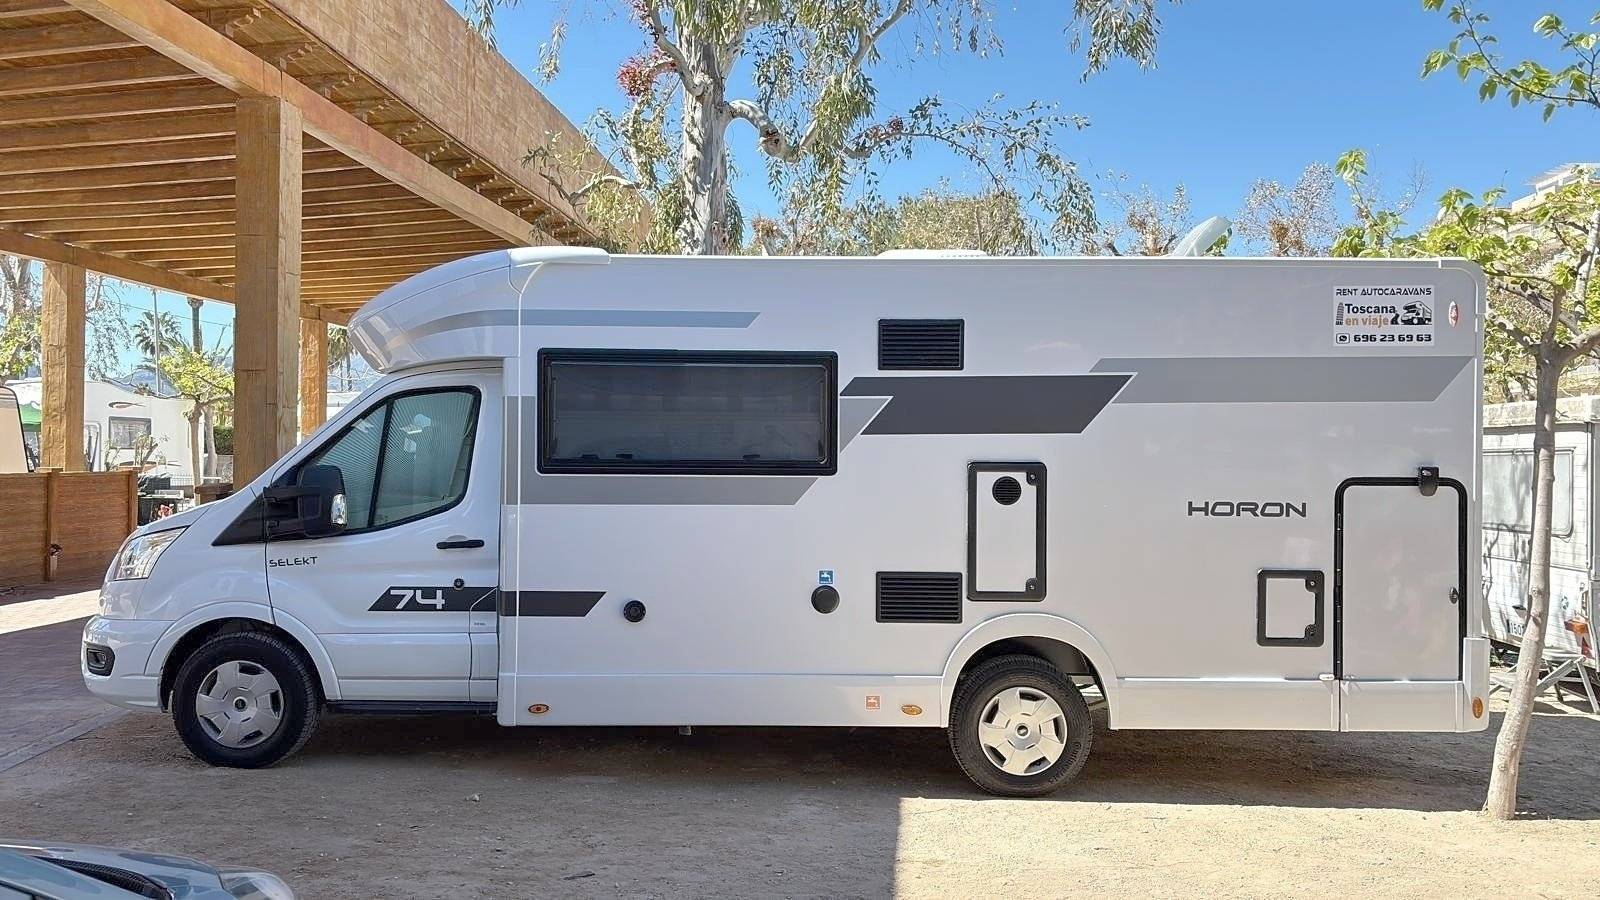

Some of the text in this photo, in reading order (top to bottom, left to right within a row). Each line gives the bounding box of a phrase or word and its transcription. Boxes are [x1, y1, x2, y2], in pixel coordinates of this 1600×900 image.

[1336, 287, 1432, 296] RENT AUTOCARAVANS
[1344, 303, 1396, 314] Toscana
[1345, 315, 1389, 328] en viaje
[1353, 334, 1432, 342] 696 23 69 63
[1187, 501, 1307, 518] HORON
[269, 556, 318, 568] SELEKT
[390, 589, 446, 610] 74
